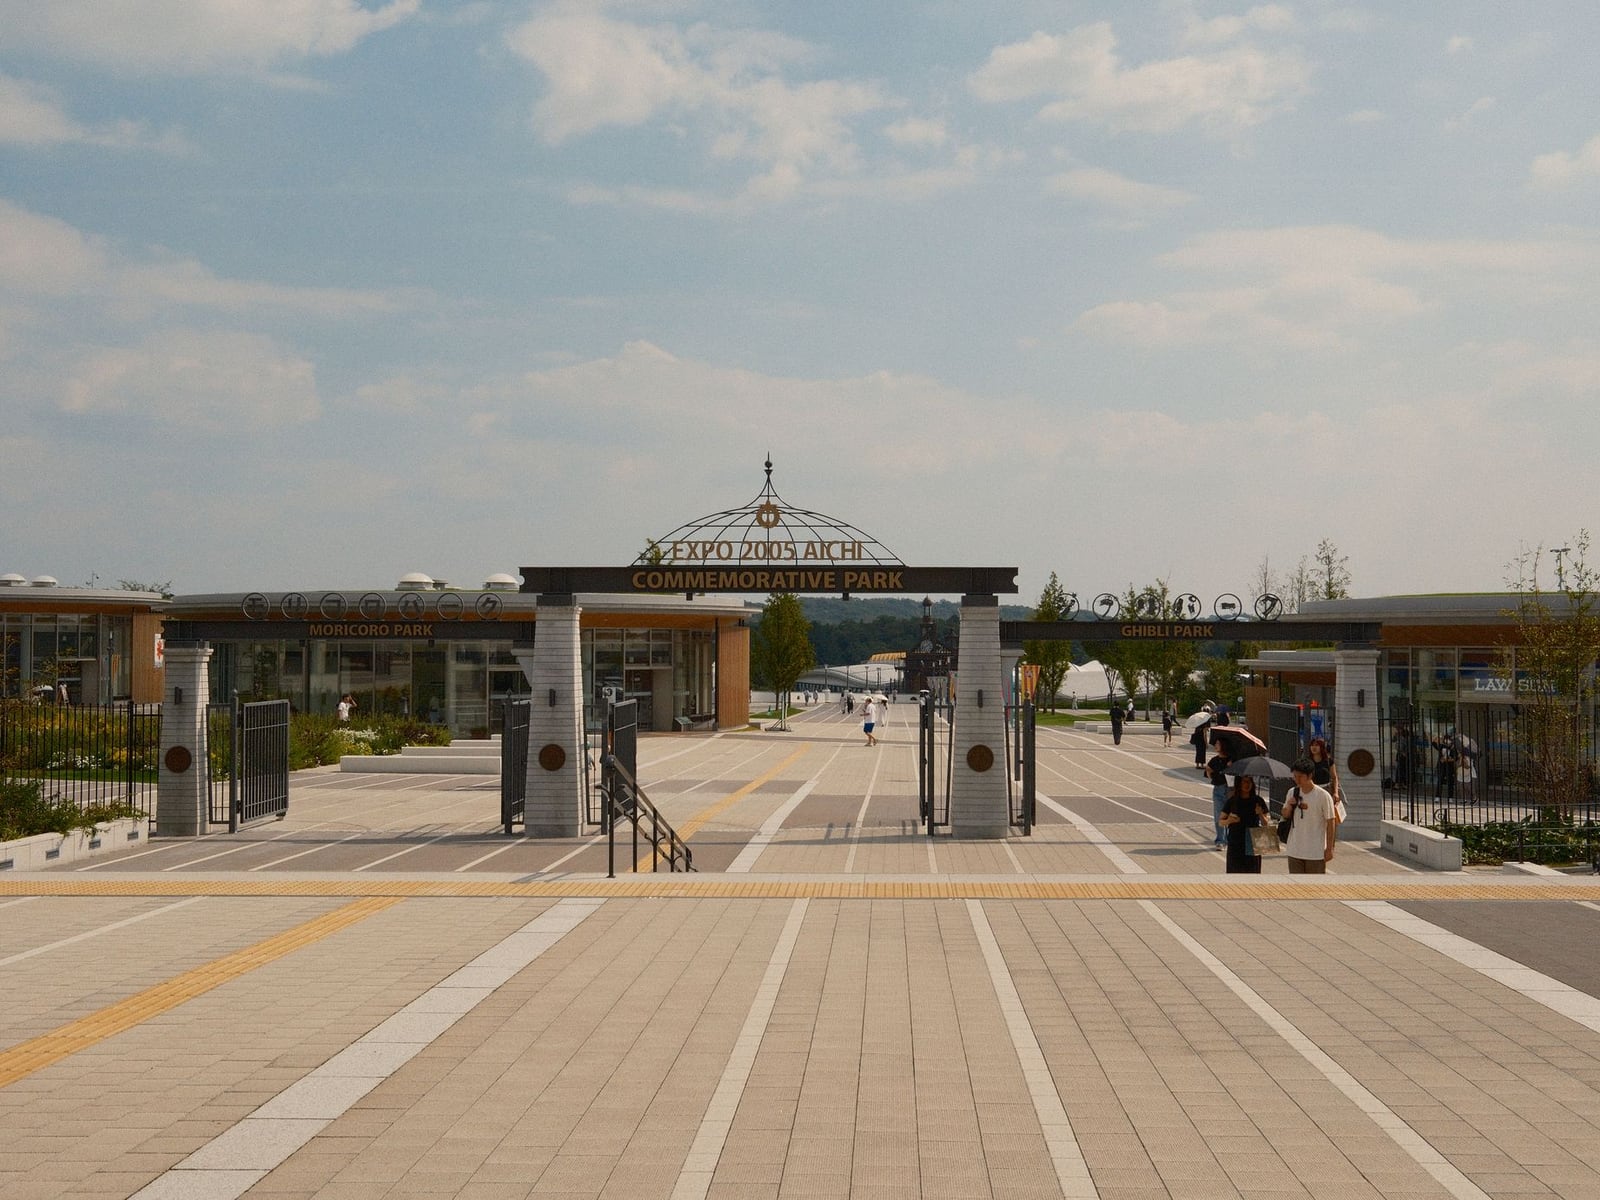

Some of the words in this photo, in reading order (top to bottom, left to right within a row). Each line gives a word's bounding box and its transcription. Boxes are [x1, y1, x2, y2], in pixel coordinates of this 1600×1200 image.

[673, 541, 733, 561] EXPO
[742, 541, 796, 561] 2005
[804, 541, 864, 561] AICHI
[632, 571, 836, 590] COMMEMORATIVE
[844, 571, 904, 590] PARK
[243, 595, 502, 617] モリコロパーク
[309, 624, 389, 637] MORICORO
[395, 624, 433, 637] PARK
[1121, 625, 1169, 637] GHIBLI
[1174, 625, 1213, 637] PARK
